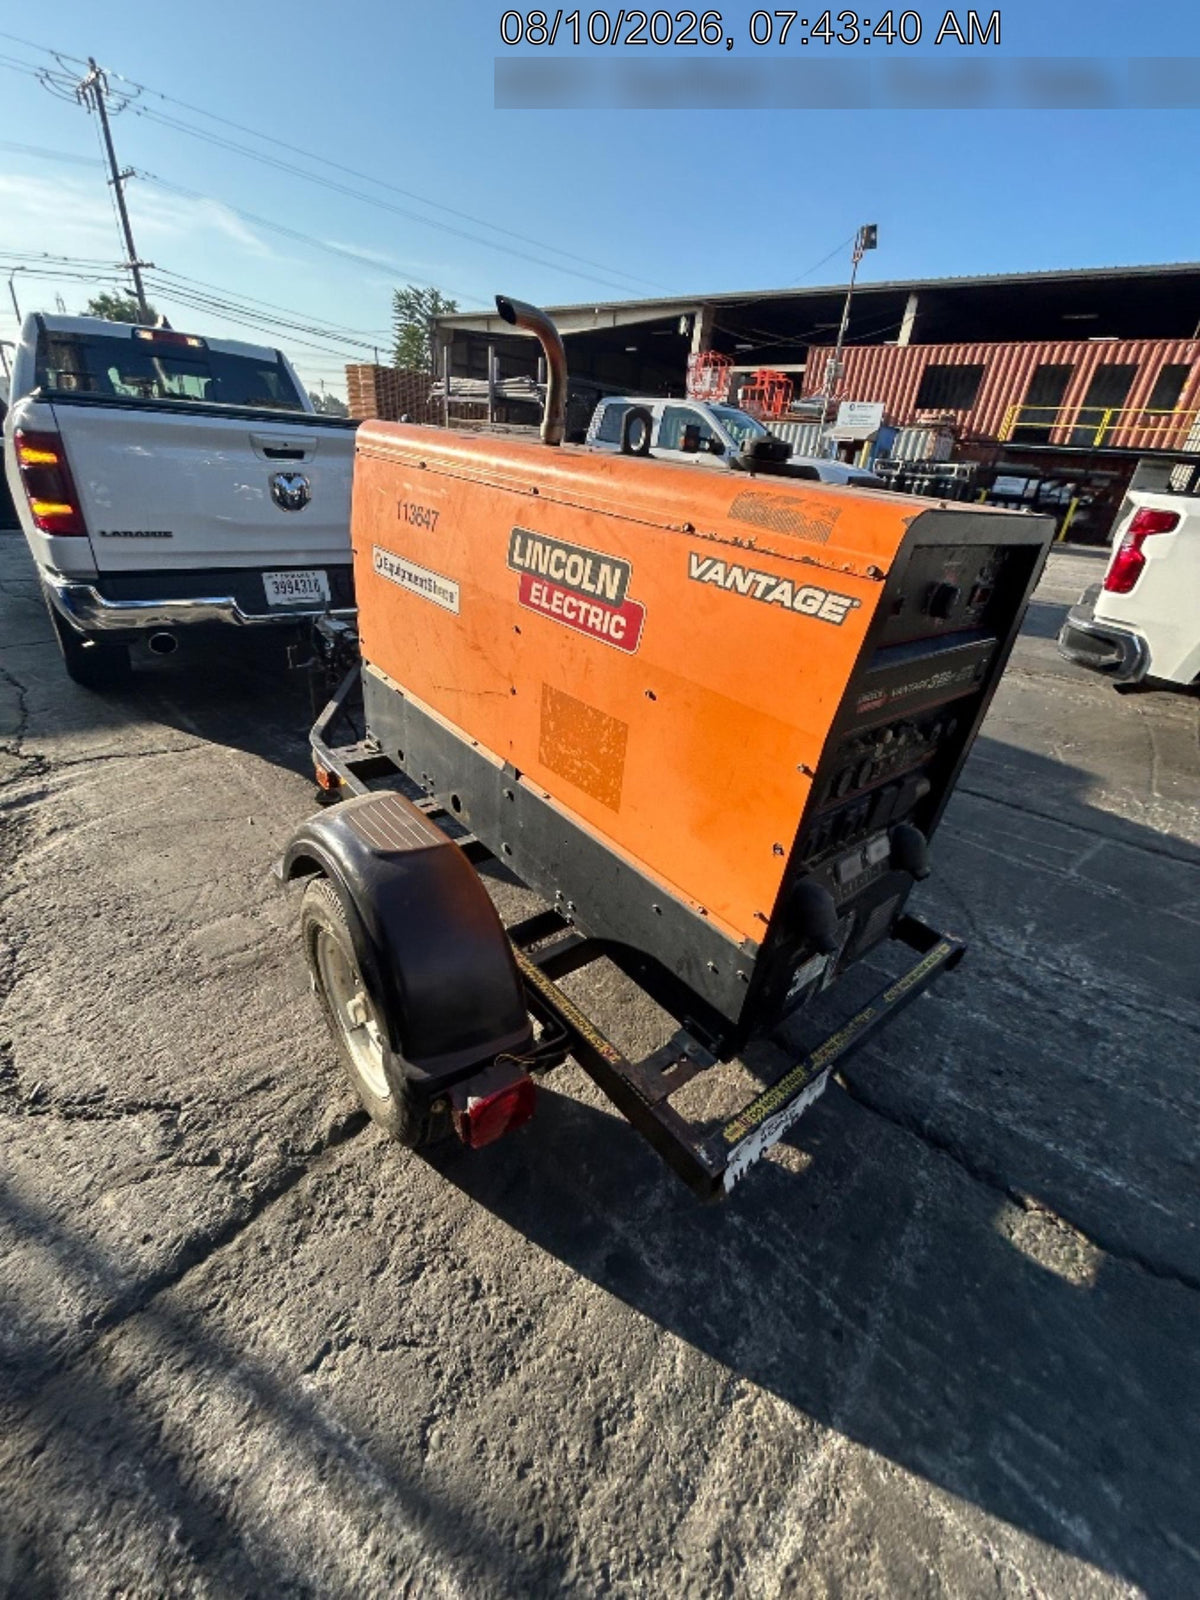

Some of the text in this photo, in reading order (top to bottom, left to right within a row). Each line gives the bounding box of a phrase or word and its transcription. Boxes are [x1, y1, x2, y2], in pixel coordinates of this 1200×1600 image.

[396, 499, 440, 533] 113647
[512, 534, 622, 600] LINCOLN
[689, 552, 853, 625] VANTAGE
[528, 580, 627, 640] ELECTRIC
